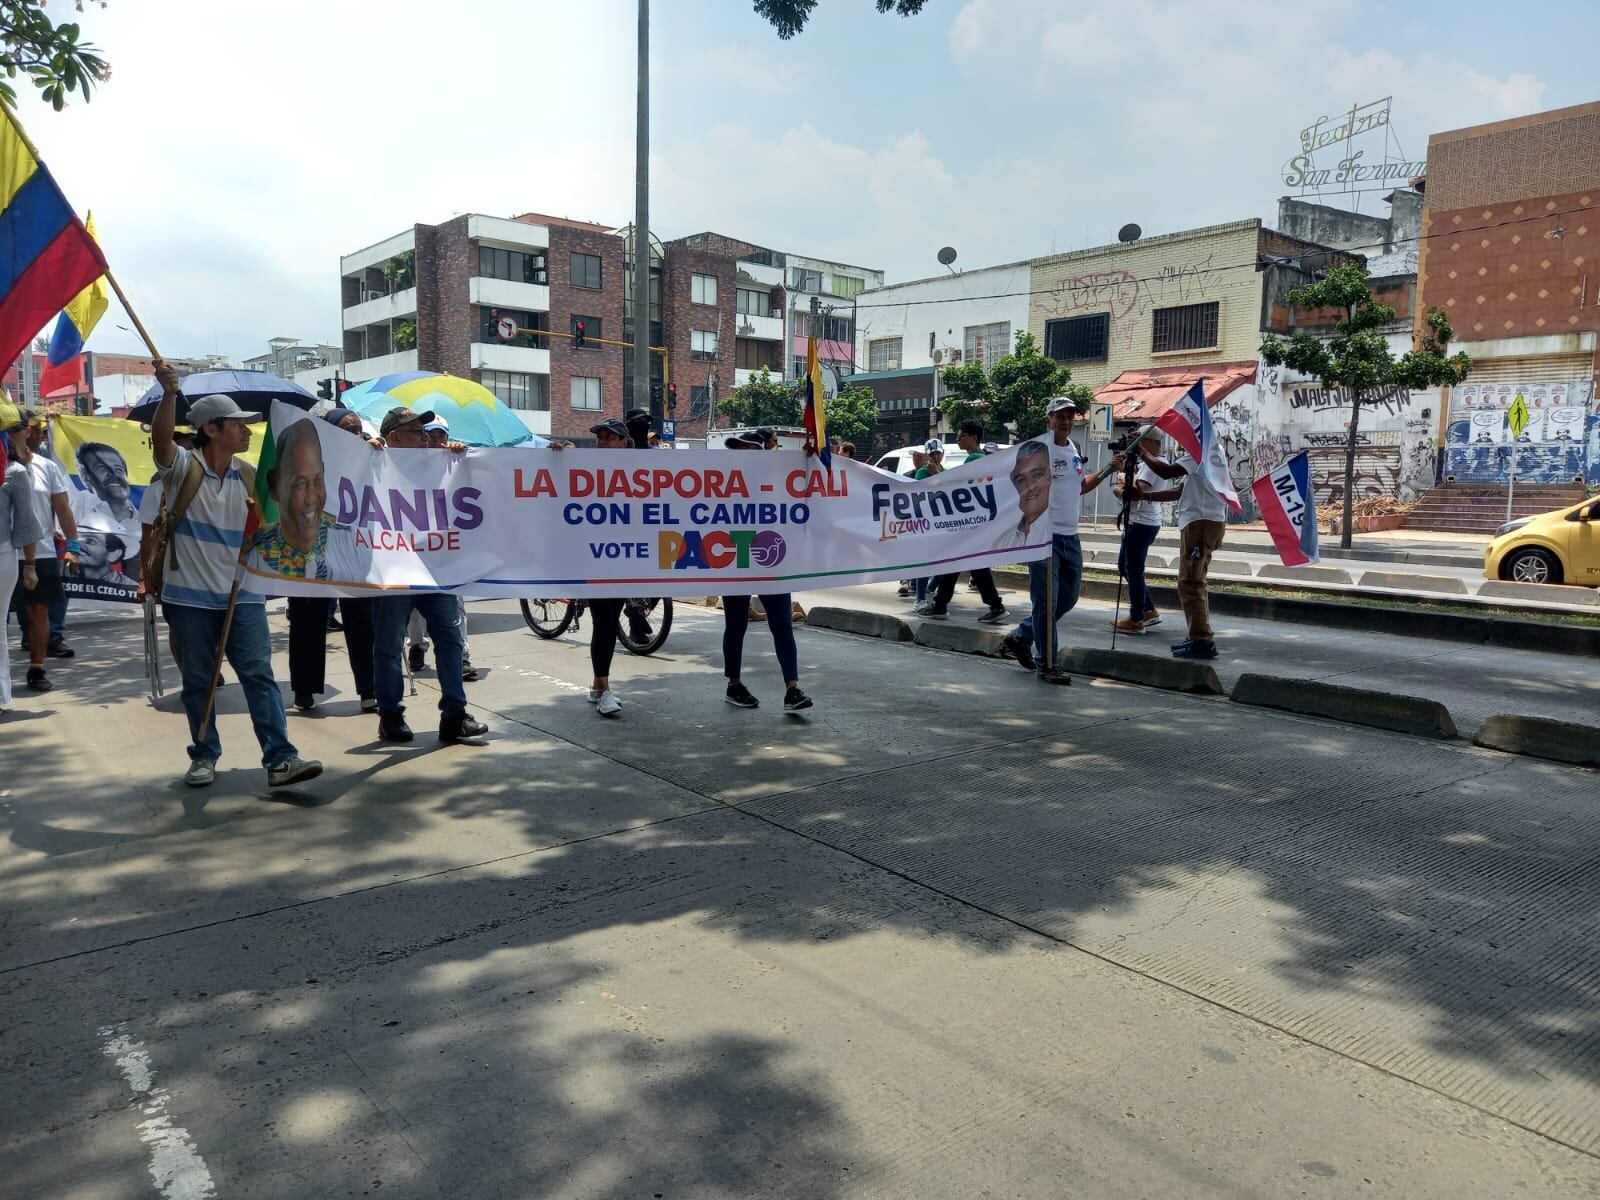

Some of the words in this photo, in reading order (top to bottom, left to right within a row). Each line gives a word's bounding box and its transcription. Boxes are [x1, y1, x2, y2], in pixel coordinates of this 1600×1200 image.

[1300, 97, 1392, 152] Teatro
[1285, 156, 1331, 188] San
[514, 468, 558, 498] LA
[569, 468, 750, 499] DIASPORA
[760, 484, 774, 492] -
[785, 469, 848, 499] CALI
[872, 476, 998, 522] Ferney
[336, 475, 484, 532] DANIS
[563, 502, 631, 525] CON
[642, 502, 680, 525] EL
[690, 502, 810, 525] CAMBIO
[879, 511, 931, 542] Lozano
[934, 515, 988, 529] GOBERNACIÓN
[355, 529, 460, 553] ALCALDE
[589, 542, 650, 559] VOTE
[658, 530, 787, 570] PACTO
[86, 584, 96, 593] EL
[97, 586, 126, 597] CIELO
